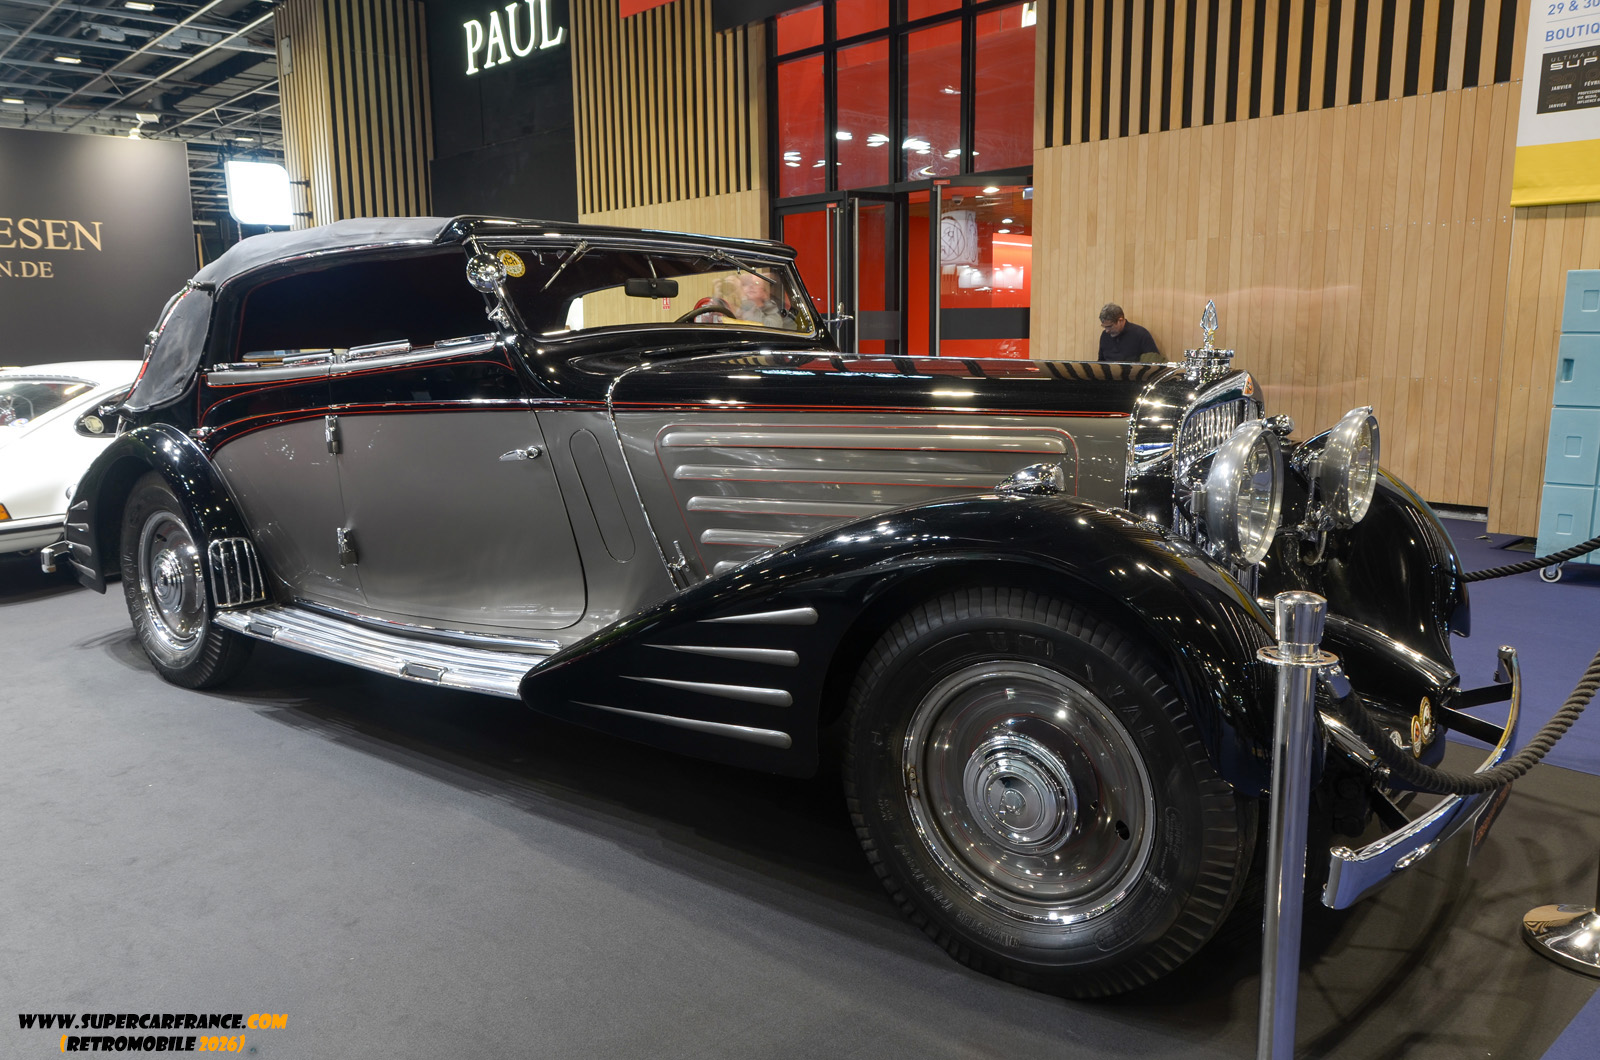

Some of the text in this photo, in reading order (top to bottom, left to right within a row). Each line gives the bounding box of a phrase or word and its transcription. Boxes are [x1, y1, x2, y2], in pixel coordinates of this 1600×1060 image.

[1547, 2, 1565, 16] 29
[1568, 0, 1579, 12] &
[463, 0, 564, 75] PAUL
[1545, 22, 1600, 42] BOUTIQ
[1550, 50, 1597, 62] ULTIMATE
[1550, 56, 1598, 71] SUP
